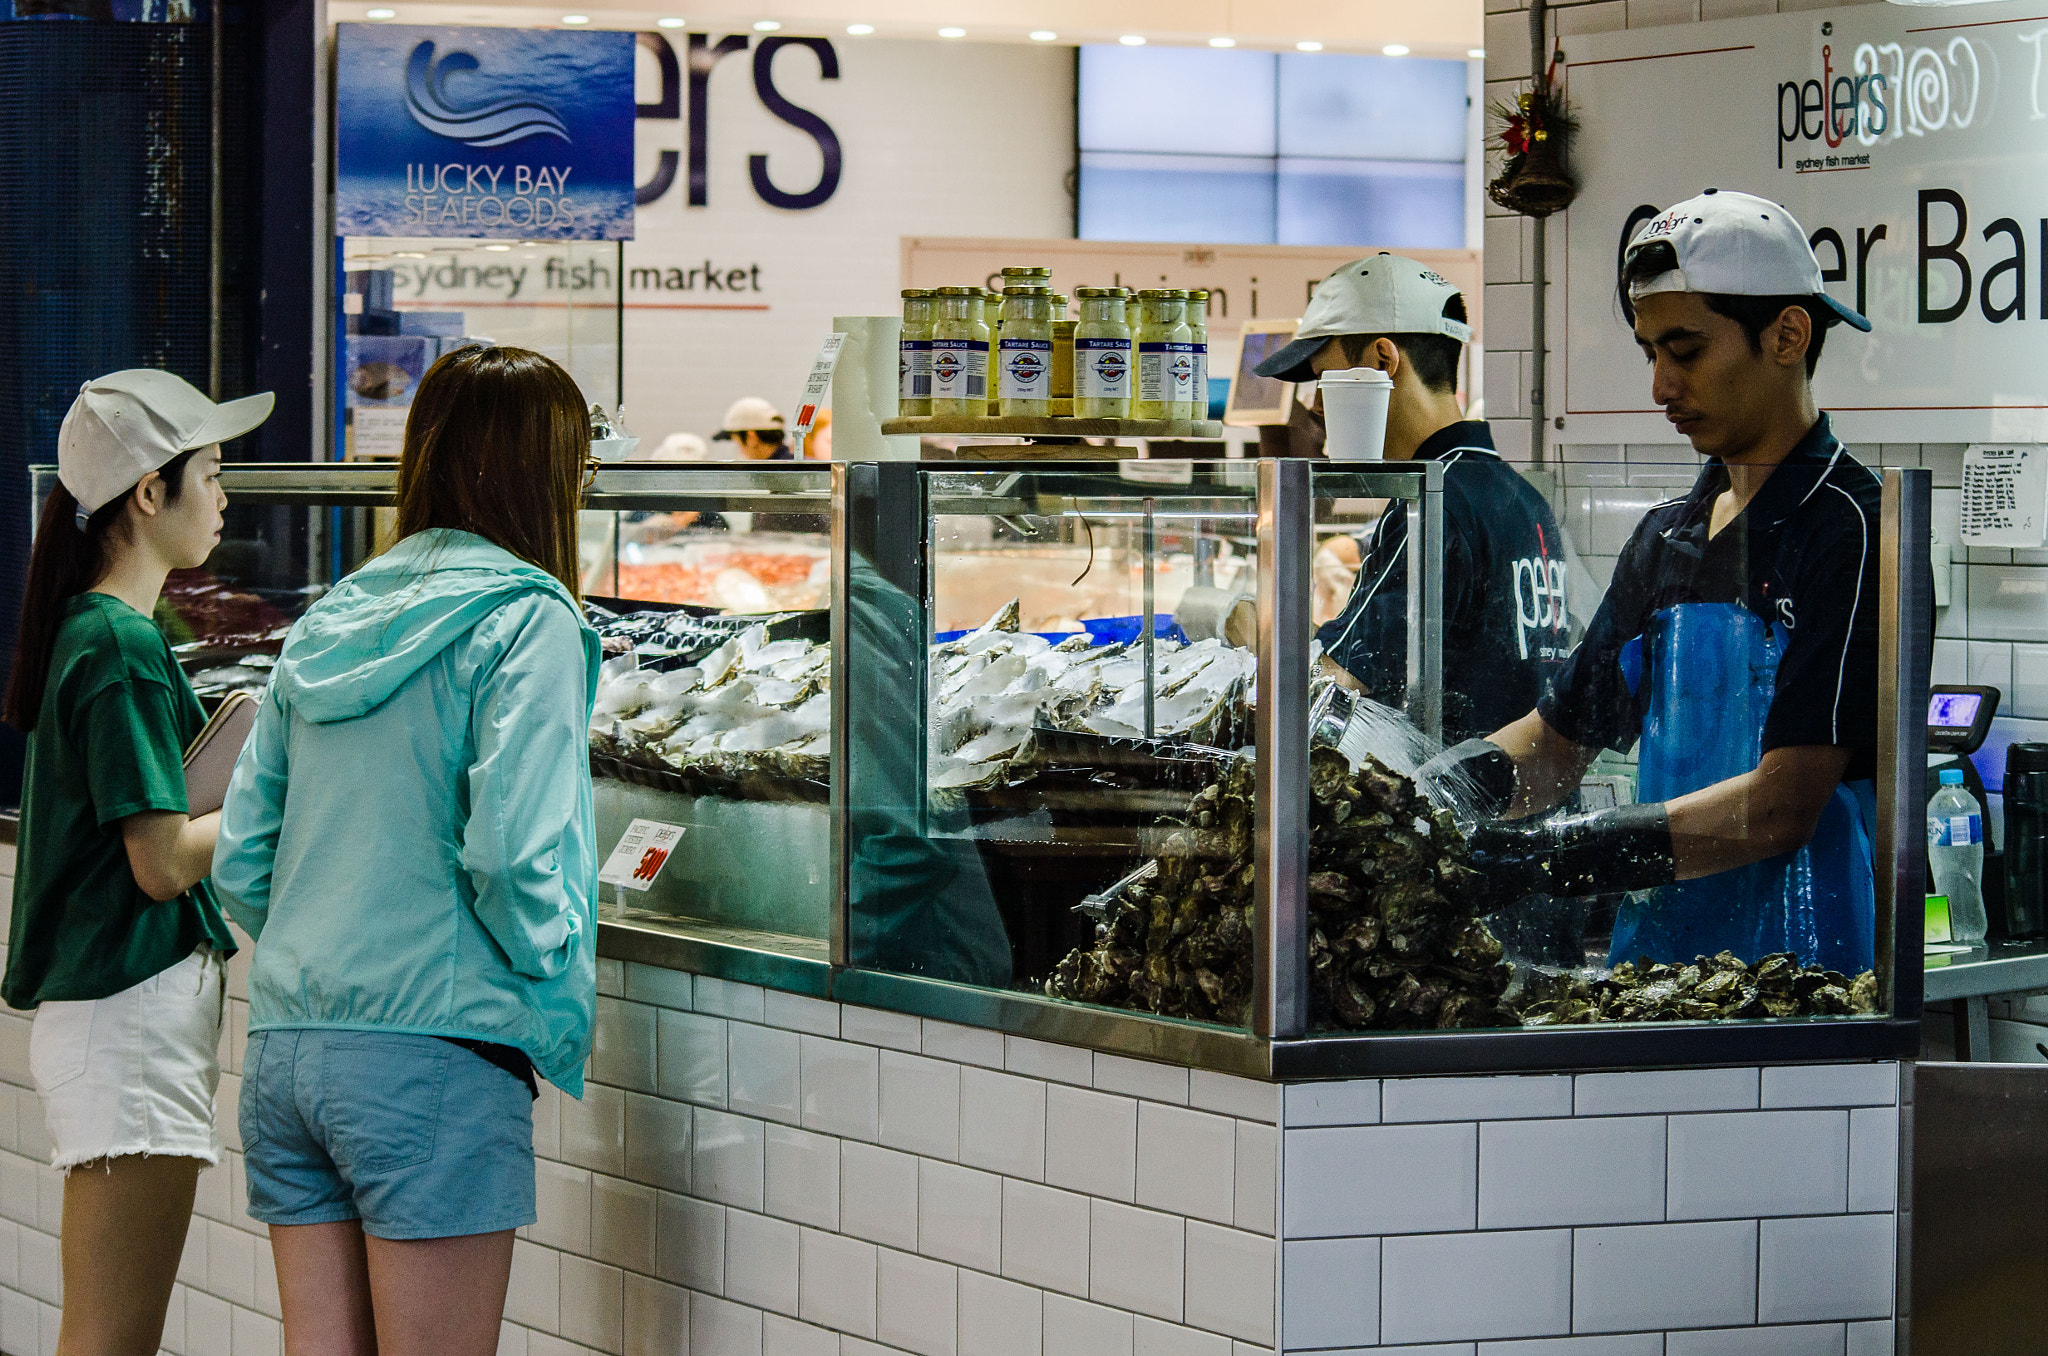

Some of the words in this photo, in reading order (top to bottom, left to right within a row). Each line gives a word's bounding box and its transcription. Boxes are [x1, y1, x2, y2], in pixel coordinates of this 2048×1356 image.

[1777, 44, 1888, 169] peters
[1796, 157, 1824, 169] sydney
[1825, 156, 1840, 167] fish
[1841, 153, 1870, 166] market
[406, 163, 503, 195] LUCKY
[515, 165, 573, 197] BAY
[403, 195, 575, 229] SEAFOODS
[391, 256, 527, 299] sydney
[544, 256, 611, 290] fish
[629, 262, 763, 293] market
[1004, 340, 1029, 349] TARTARE
[1030, 341, 1049, 349] SAUCE
[1088, 340, 1114, 348] TARTARE
